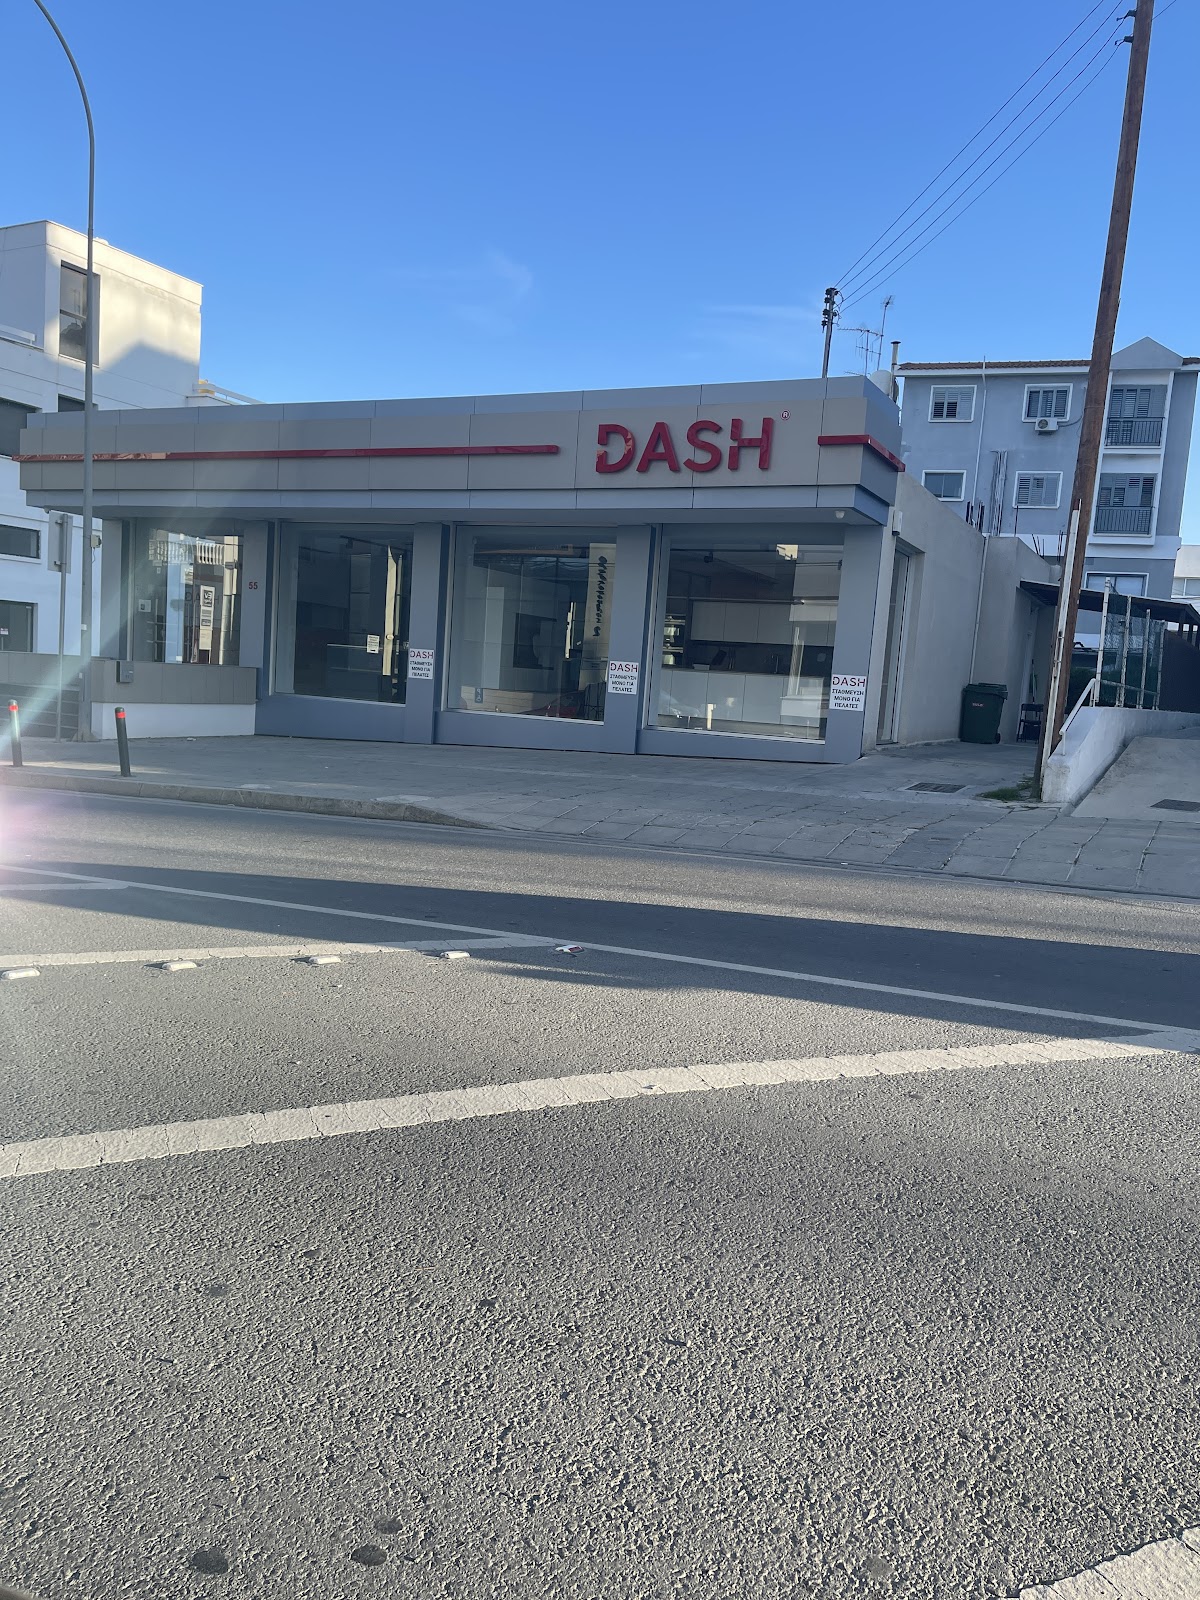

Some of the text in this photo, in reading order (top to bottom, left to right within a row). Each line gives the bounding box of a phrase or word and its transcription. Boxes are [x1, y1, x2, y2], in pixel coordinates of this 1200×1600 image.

[596, 417, 775, 473] DASH
[248, 581, 259, 590] 55
[610, 662, 638, 673] DASH
[832, 676, 866, 688] DASH
